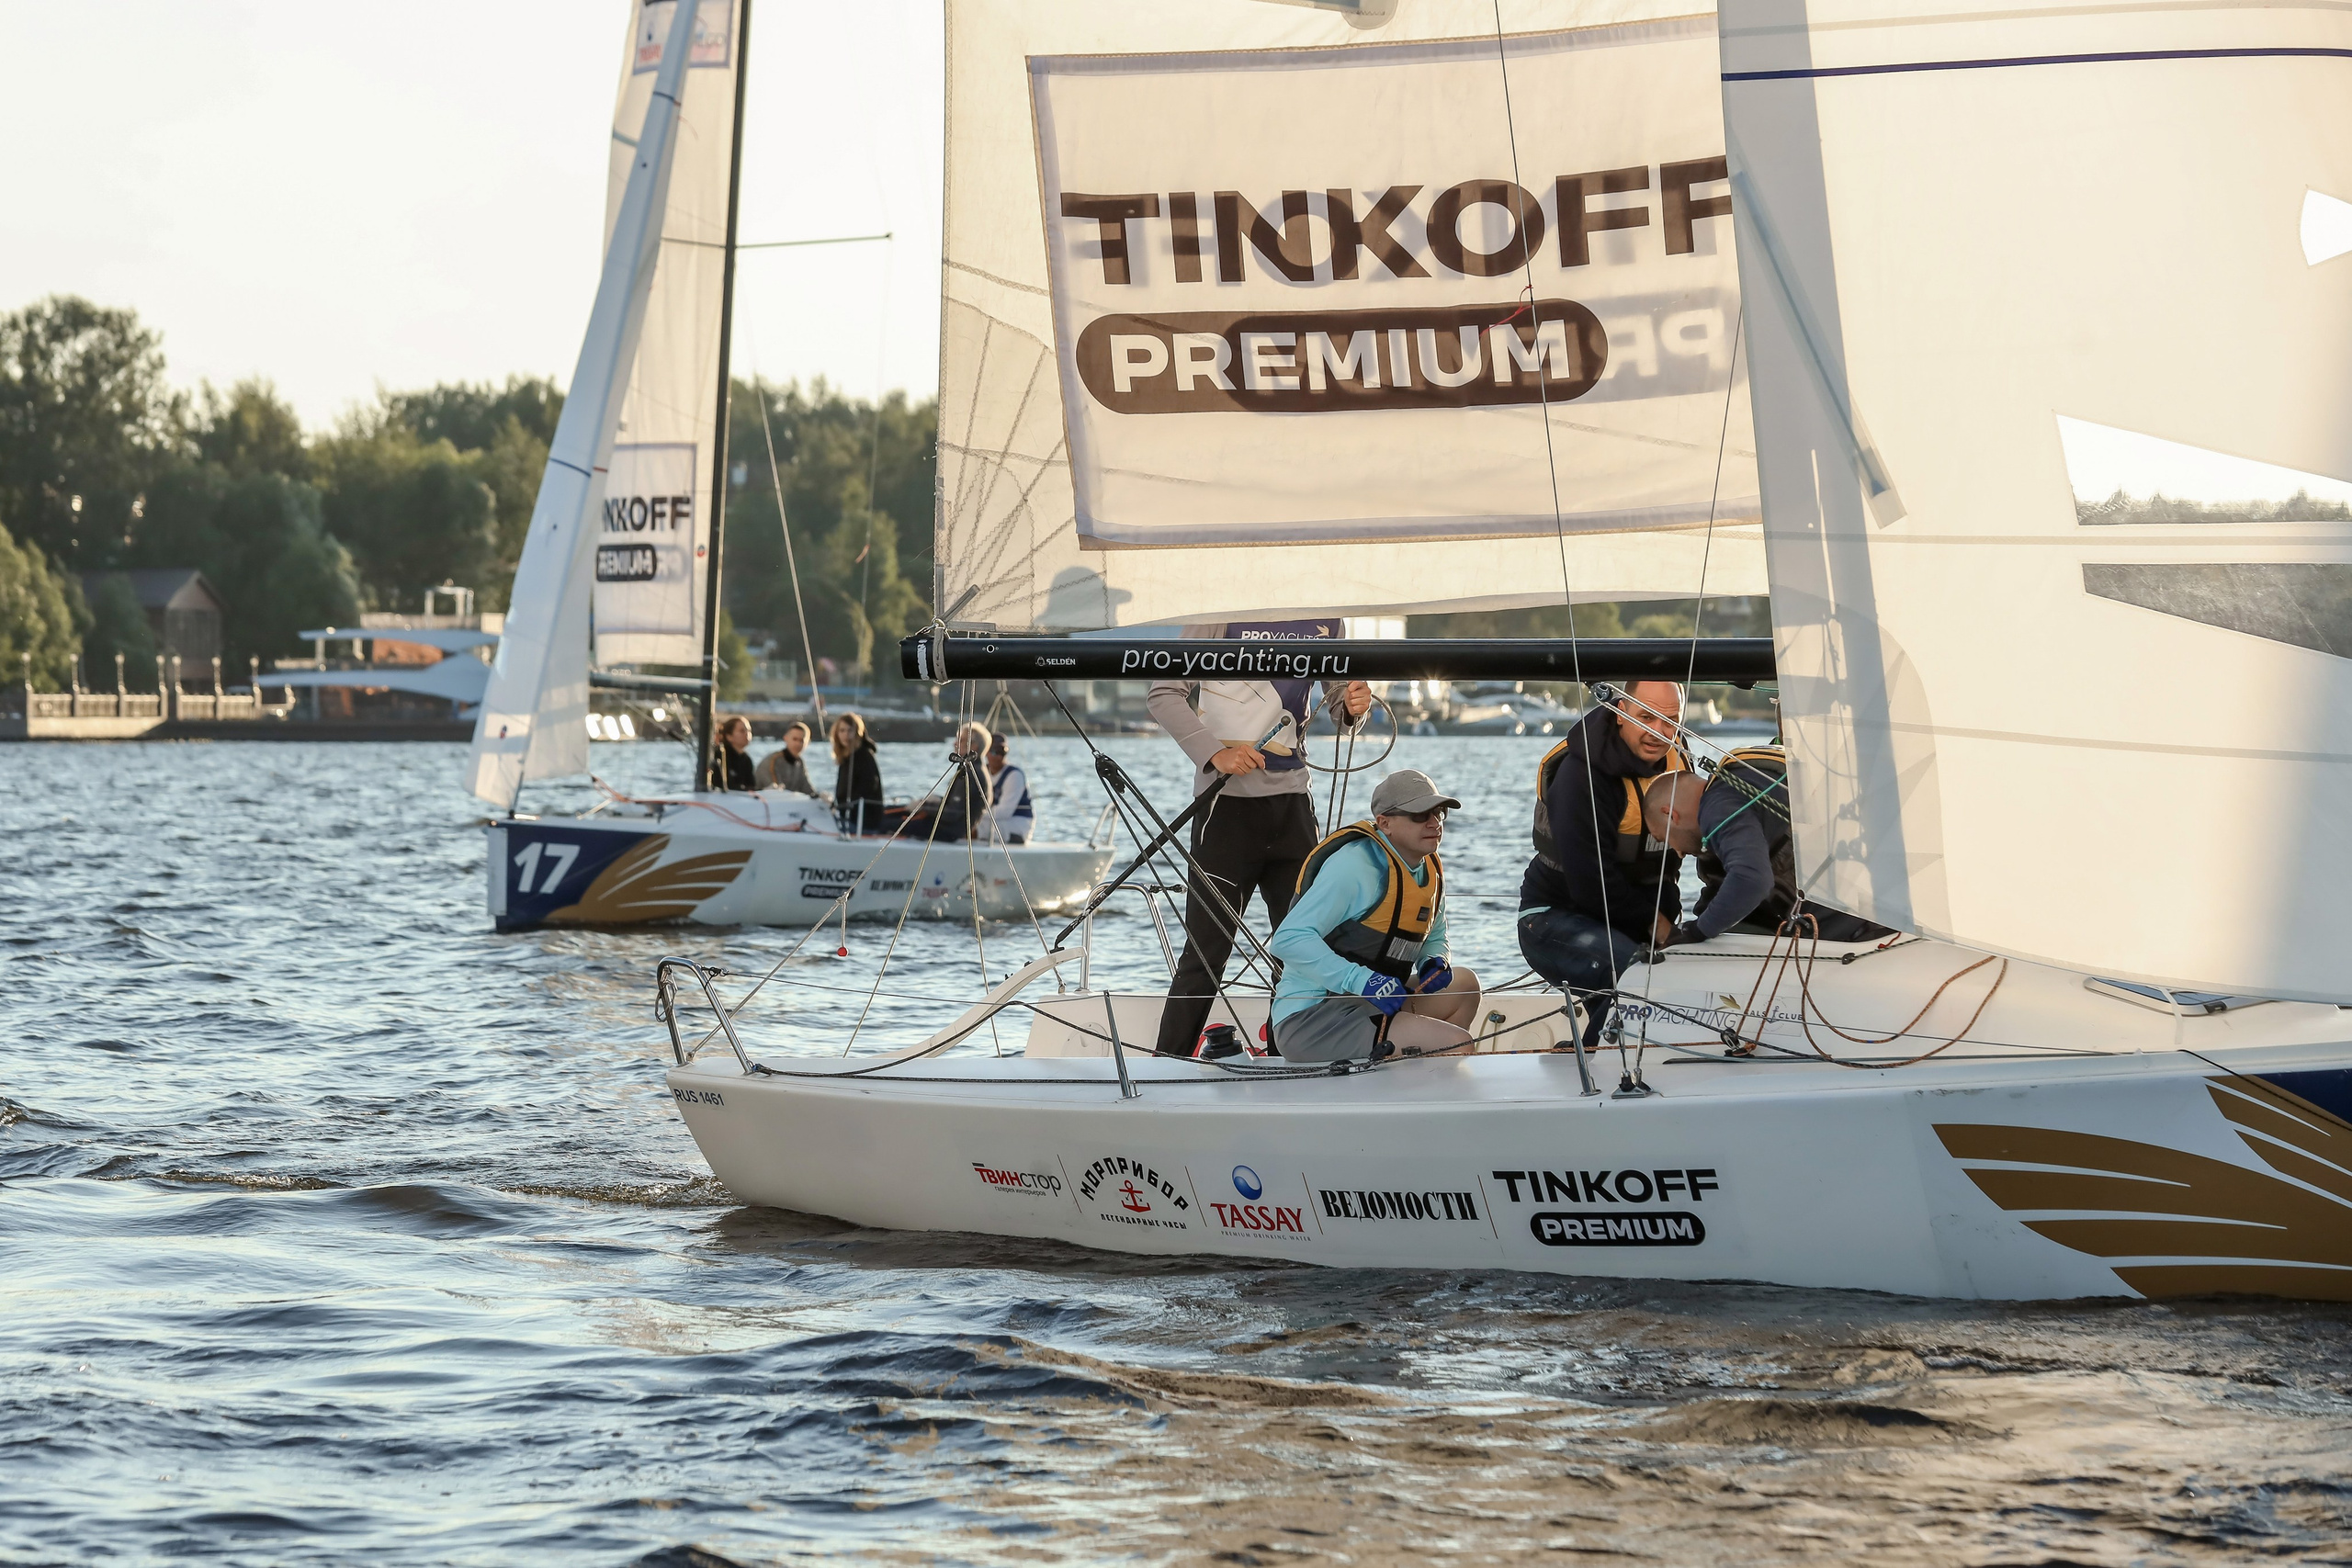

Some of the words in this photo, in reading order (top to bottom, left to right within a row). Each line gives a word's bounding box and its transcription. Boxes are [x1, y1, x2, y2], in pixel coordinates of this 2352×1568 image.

[1060, 154, 1733, 285] TINKOFF
[1109, 319, 1571, 394] PREMIUM
[603, 496, 690, 532] NKOFF
[1046, 656, 1076, 666] SELDÉN
[1121, 647, 1351, 679] pro-yachting.ru
[514, 841, 581, 895] 17
[1374, 977, 1399, 1000] FOX
[673, 1089, 698, 1103] RUS
[698, 1091, 724, 1106] 1461
[1080, 1156, 1190, 1211] МОРПРИБОР
[1492, 1168, 1719, 1203] TINKOFF
[1100, 1213, 1160, 1226] ЛЕГЕНДАРНЫЕ
[1162, 1220, 1187, 1229] ЧАСЫ
[1210, 1202, 1305, 1233] TASSAY
[1318, 1190, 1480, 1223] ВЕДОМОСТИ
[1221, 1230, 1251, 1238] PREMIUM
[1253, 1233, 1287, 1241] DRINKING
[1539, 1218, 1695, 1240] PREMIUM
